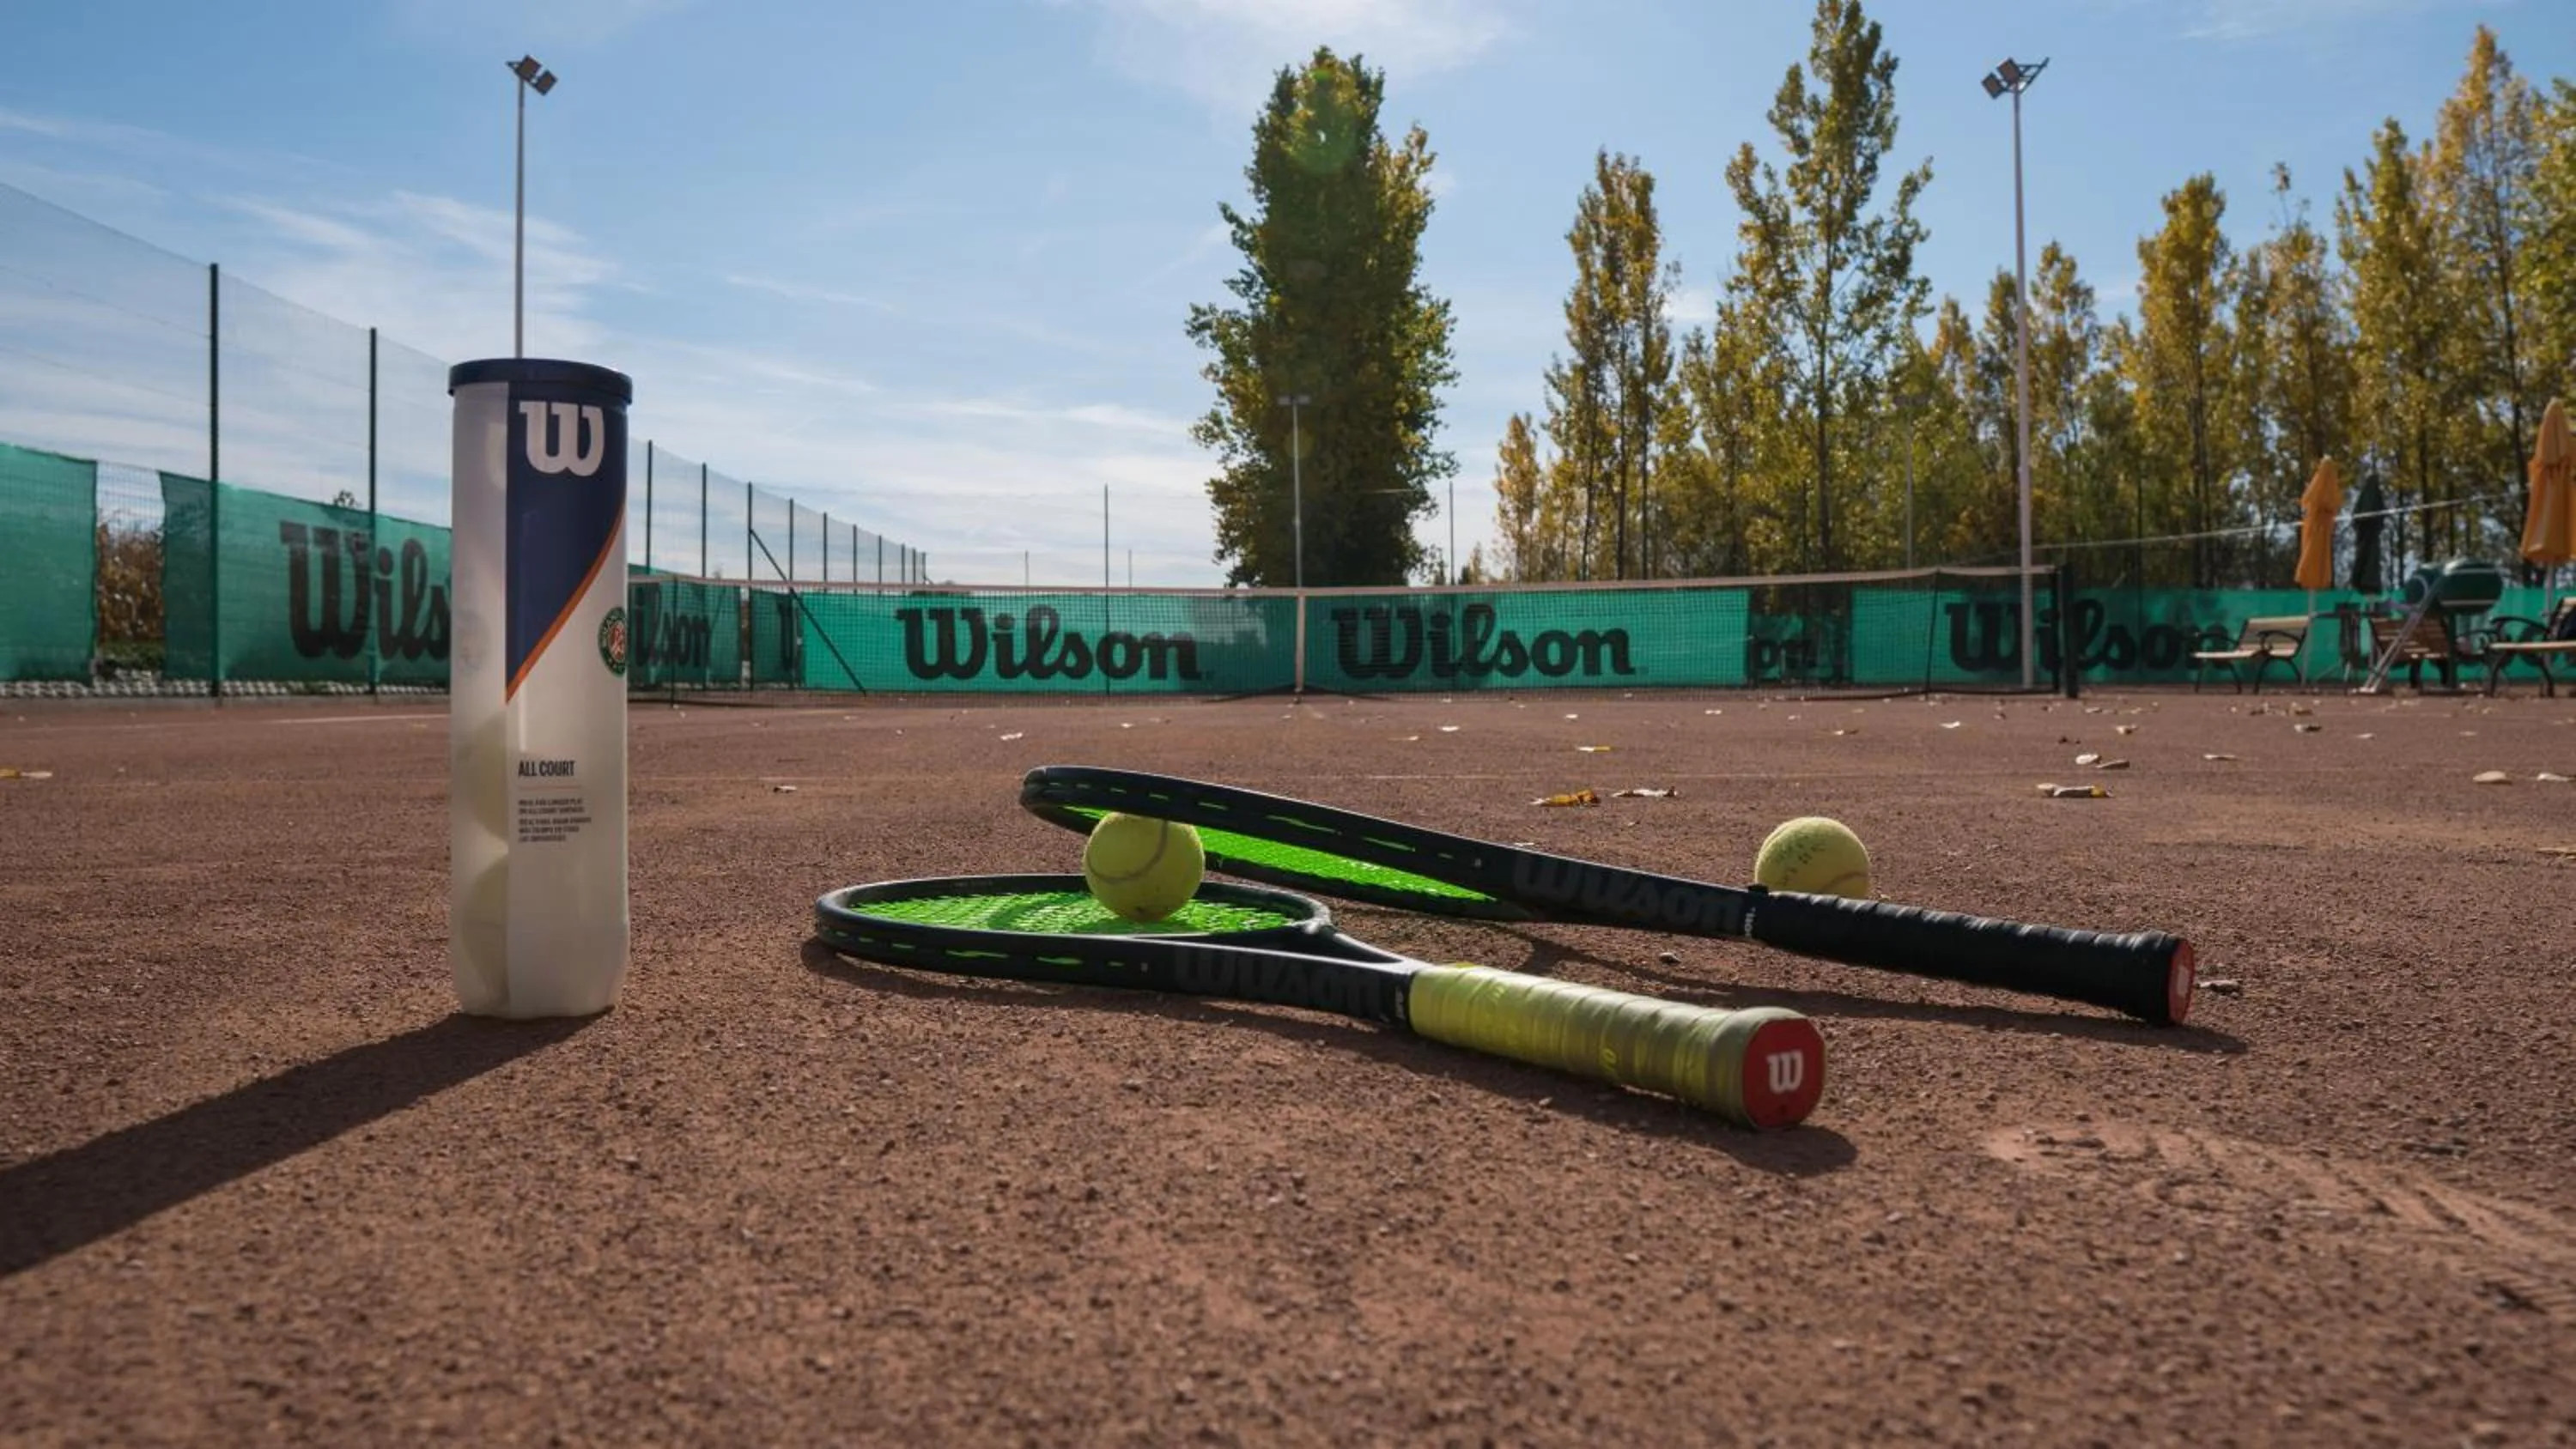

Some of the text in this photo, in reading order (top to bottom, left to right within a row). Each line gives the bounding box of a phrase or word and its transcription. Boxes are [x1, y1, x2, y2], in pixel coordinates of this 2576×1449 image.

[279, 520, 451, 661] Wils
[628, 584, 710, 669] ilson
[895, 606, 1201, 681] Wilson
[1332, 603, 1636, 680] Wilson
[518, 760, 576, 777] ALL COURT
